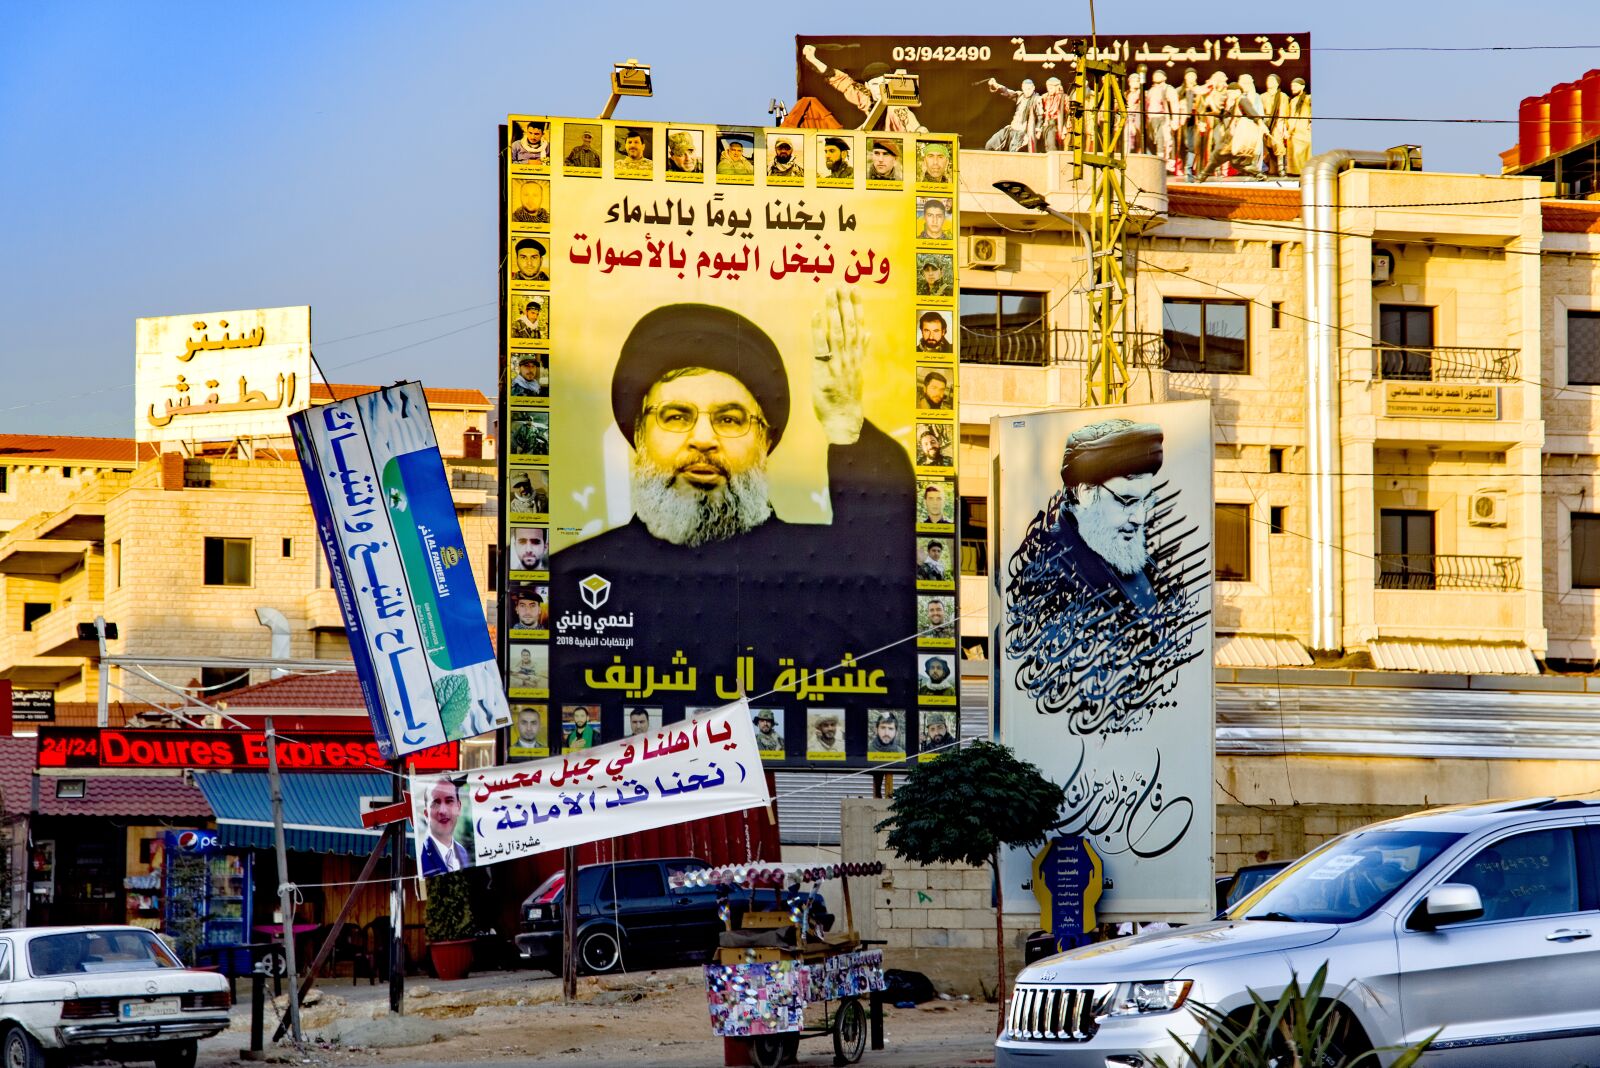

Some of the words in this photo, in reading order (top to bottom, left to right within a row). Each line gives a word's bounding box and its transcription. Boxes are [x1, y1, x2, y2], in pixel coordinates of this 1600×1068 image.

[892, 46, 991, 62] 03/942490
[1135, 39, 1221, 67] المجد
[1226, 35, 1300, 66] فرقة
[604, 195, 695, 237] بالدماء
[765, 199, 827, 241] بخلنا
[838, 203, 857, 232] ما
[569, 232, 687, 280] بالأصوات
[697, 244, 759, 282] اليوم
[770, 242, 834, 283] نبخل
[844, 248, 890, 285] ولن
[177, 320, 264, 362] سنتر
[432, 551, 446, 583] FAKHER
[556, 610, 592, 633] ونبني
[594, 612, 633, 634] نحمي
[556, 636, 573, 645] 2018
[574, 637, 598, 647] النيابية
[584, 650, 696, 698] شريف
[715, 646, 754, 701] آل
[773, 652, 888, 701] عشيرة
[43, 738, 97, 756] 24/24
[102, 732, 234, 765] Doures
[241, 733, 387, 767] Express
[643, 719, 698, 760] أهلنا
[706, 719, 737, 751] يا
[549, 758, 601, 788] جبل
[606, 743, 635, 781] في
[474, 769, 542, 803] محسن
[606, 779, 649, 808] قد
[492, 790, 596, 830] الأمانة
[478, 842, 504, 859] شريف
[520, 836, 541, 852] عشيرة
